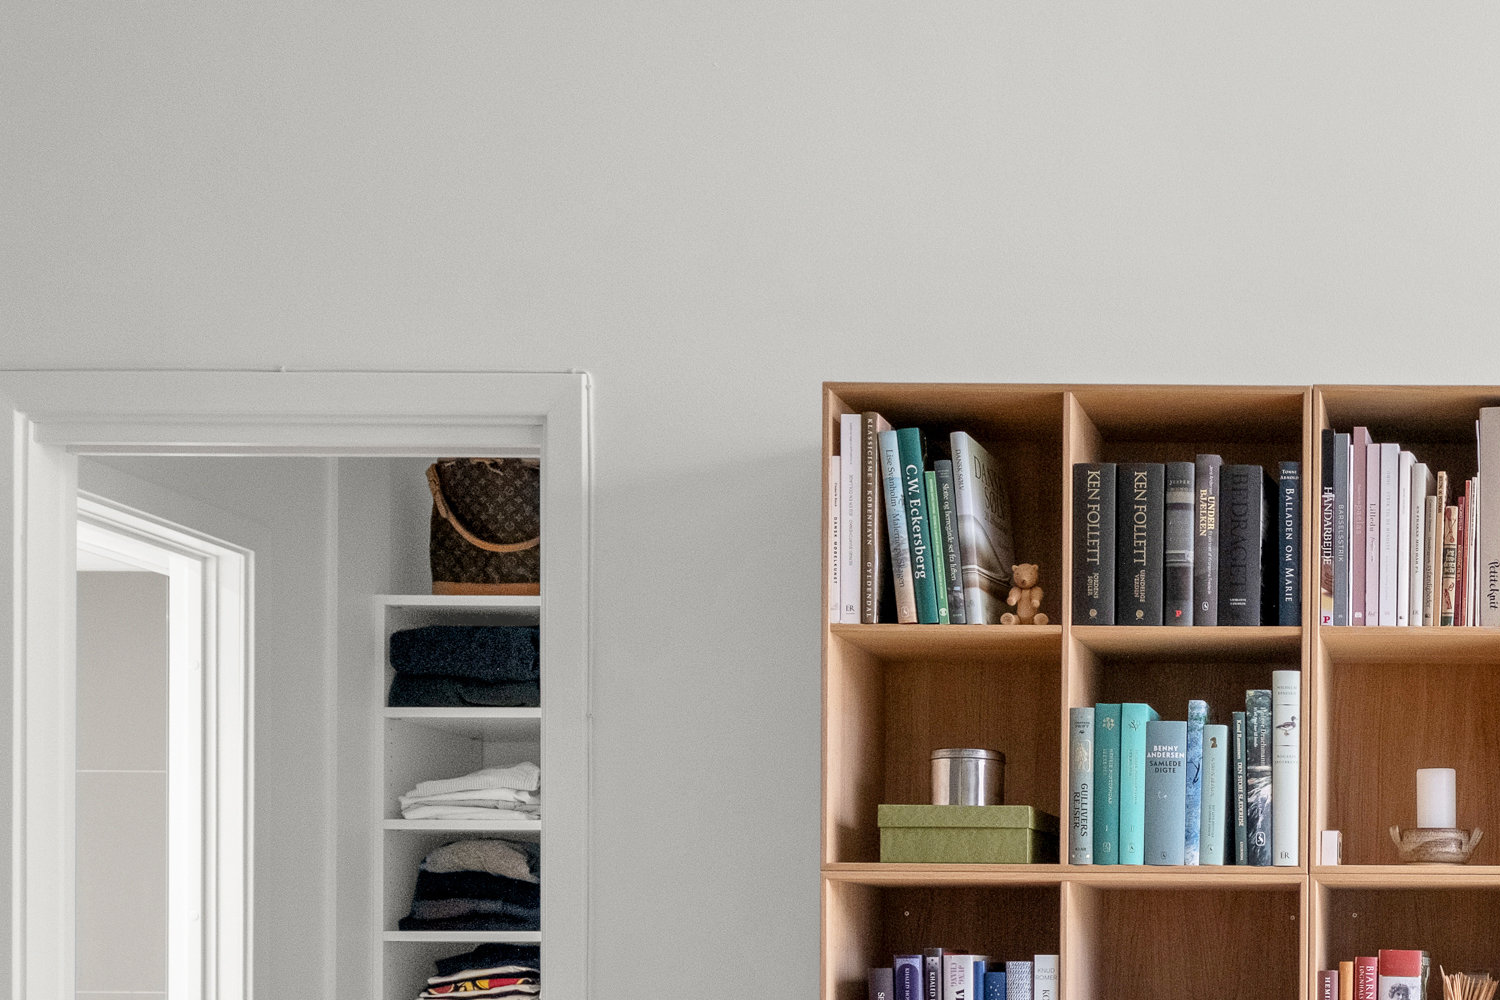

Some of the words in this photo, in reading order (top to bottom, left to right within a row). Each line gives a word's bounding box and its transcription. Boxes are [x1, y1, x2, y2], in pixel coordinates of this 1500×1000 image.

[885, 449, 893, 465] Lise
[887, 467, 898, 506] Svanholm
[906, 465, 919, 495] C.W.
[1087, 470, 1100, 500] KEN
[1134, 471, 1147, 501] KEN
[892, 514, 901, 545] Malerne
[909, 499, 926, 579] Eckersberg
[942, 483, 950, 500] Slotte
[949, 564, 957, 580] luften
[1087, 504, 1100, 564] FOLLETT
[1134, 505, 1147, 566] FOLLETT
[1231, 473, 1248, 591] BEDRAGET
[896, 560, 906, 588] Skagen
